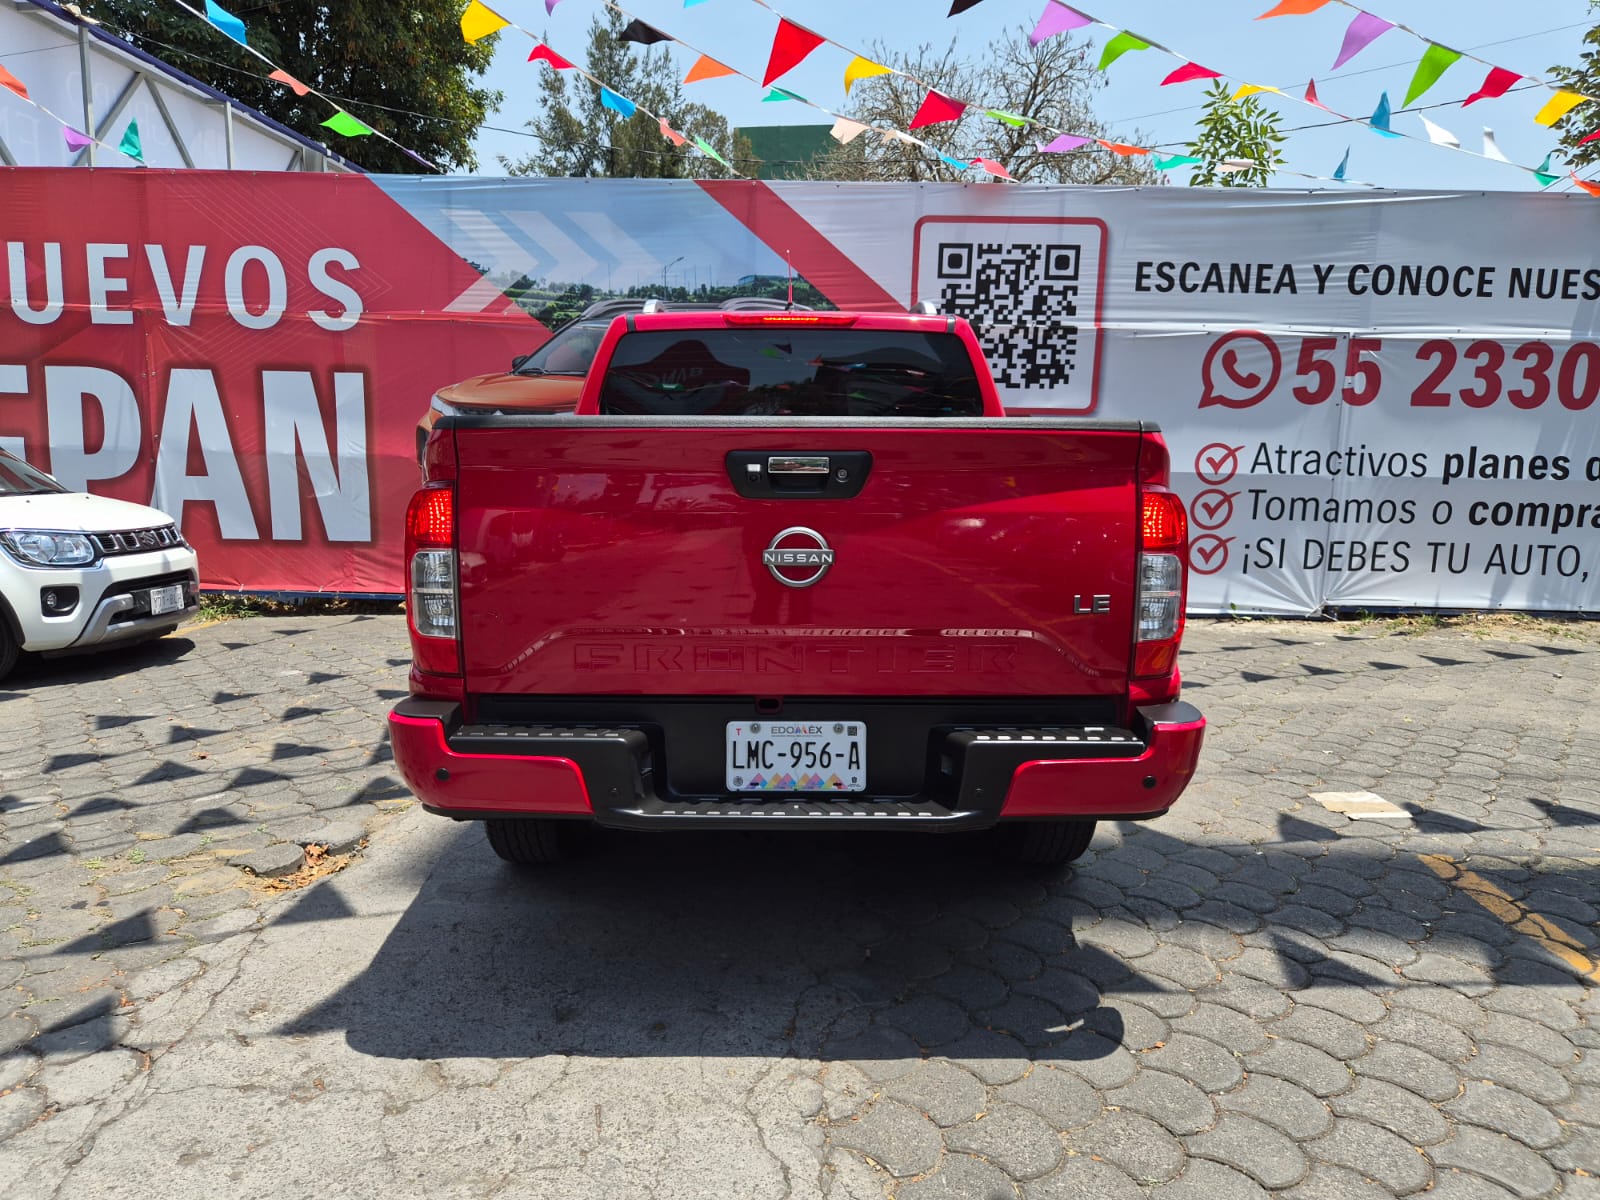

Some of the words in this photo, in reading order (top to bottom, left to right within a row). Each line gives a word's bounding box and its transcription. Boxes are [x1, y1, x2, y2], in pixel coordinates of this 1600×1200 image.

[7, 241, 364, 331] UEVOS
[1135, 261, 1298, 295] ESCANEA
[1313, 264, 1335, 295] Y
[1347, 263, 1496, 298] CONOCE
[1508, 267, 1600, 301] NUES
[1292, 338, 1382, 406] 55
[1410, 339, 1600, 411] 2330
[1250, 442, 1428, 478] Atractivos
[1441, 445, 1571, 485] planes
[1247, 488, 1417, 524] Tomamos
[1432, 500, 1453, 525] o
[764, 553, 833, 563] NISSAN
[1242, 537, 1287, 575] ¡SI
[1303, 539, 1411, 573] DEBES
[1426, 541, 1471, 574] TU
[1483, 543, 1590, 583] AUTO,
[1073, 594, 1111, 614] LE
[573, 643, 1021, 673] FRONTIER
[732, 740, 861, 769] LMC-956-A
